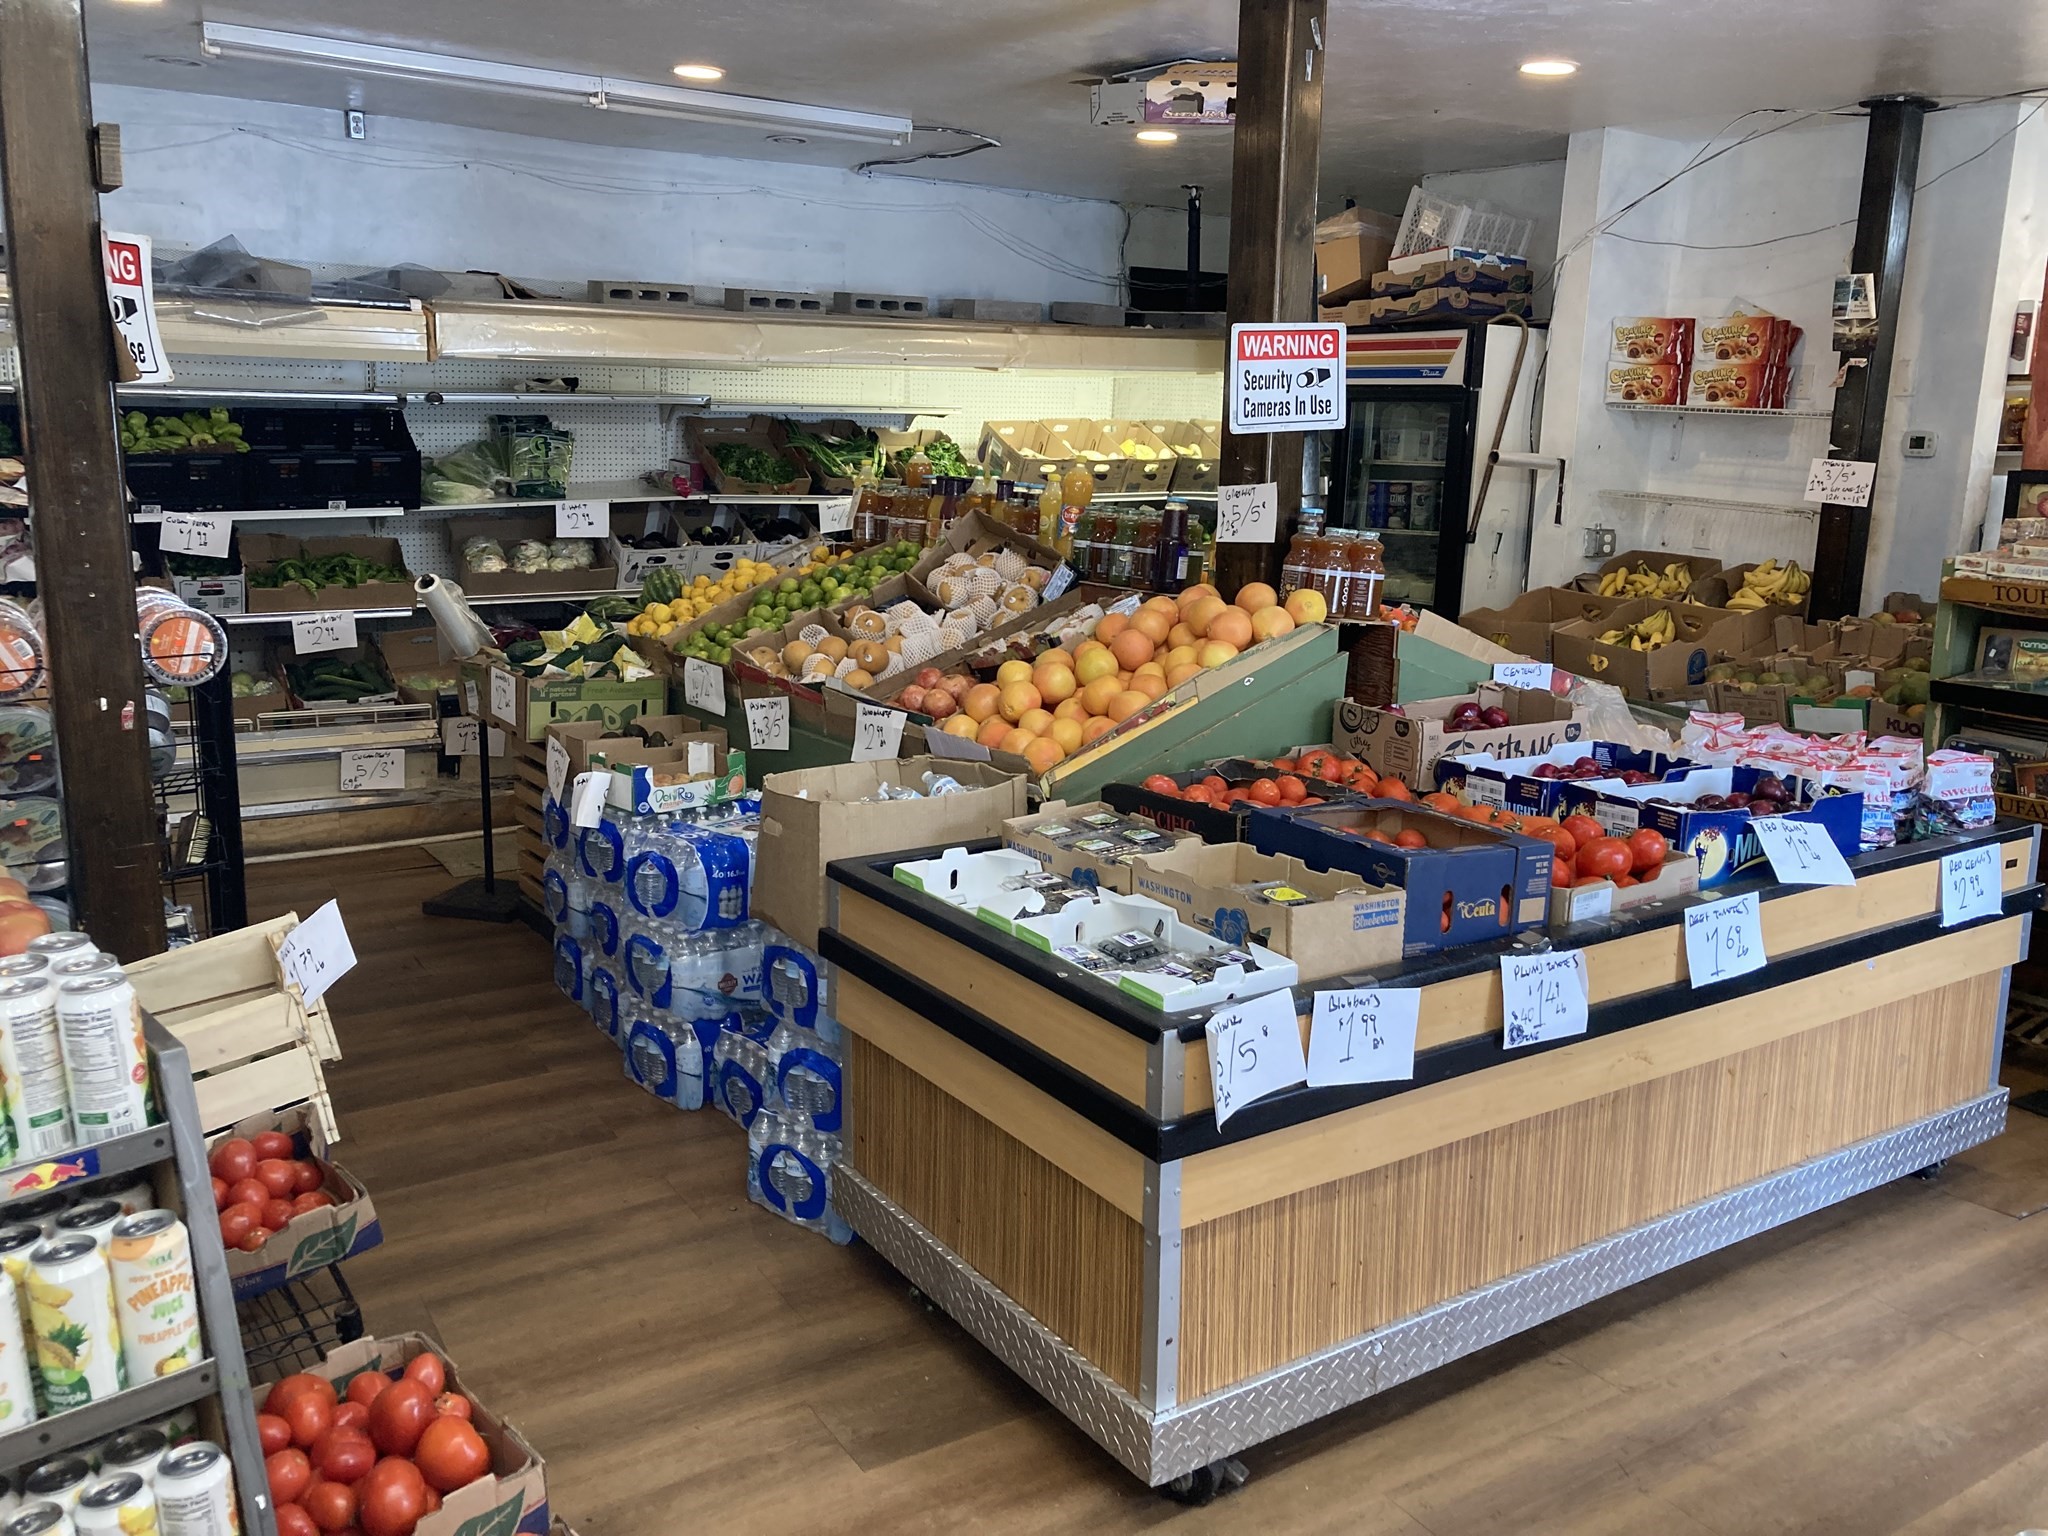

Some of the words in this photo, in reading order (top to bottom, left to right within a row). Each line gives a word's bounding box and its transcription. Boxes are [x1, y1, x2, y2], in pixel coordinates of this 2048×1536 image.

[1243, 334, 1334, 357] WARNING
[1244, 368, 1292, 394] Security
[1243, 397, 1291, 418] Cameras
[1295, 395, 1306, 416] In
[1310, 394, 1332, 415] Use
[1341, 578, 1351, 607] 100%
[1941, 785, 1979, 798] sweet
[1139, 805, 1196, 831] PACIFIC
[1760, 821, 1778, 834] RED
[1006, 839, 1053, 865] WASHINGTON
[1949, 859, 1963, 876] RED
[1138, 876, 1192, 905] WASHINGTON
[1353, 898, 1400, 912] WASHINGTON
[1353, 910, 1399, 930] Blueberries
[1361, 1013, 1377, 1036] 99
[150, 1294, 184, 1320] JUICE
